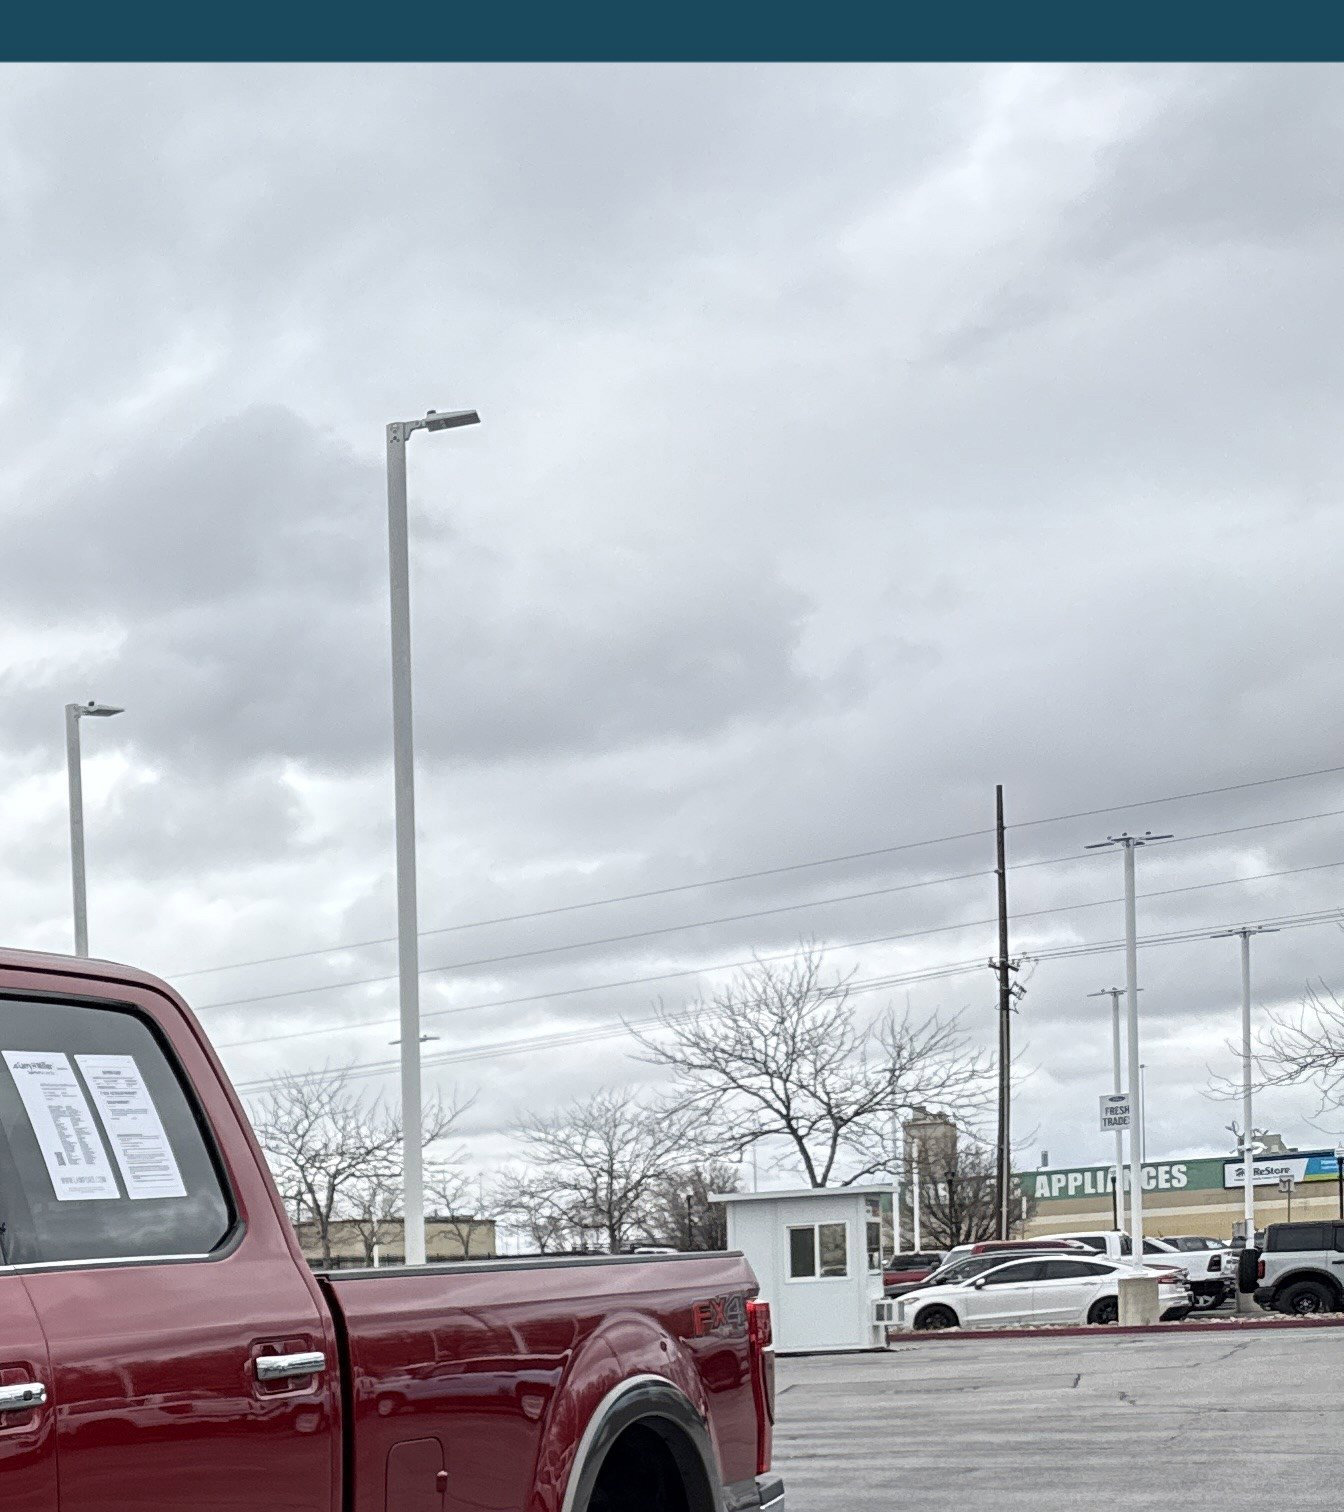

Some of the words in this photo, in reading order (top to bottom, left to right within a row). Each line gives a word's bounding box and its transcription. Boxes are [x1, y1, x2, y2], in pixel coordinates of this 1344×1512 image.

[1104, 1105, 1130, 1116] FRESH
[1102, 1115, 1130, 1127] TRADE
[693, 1293, 745, 1336] FX4
